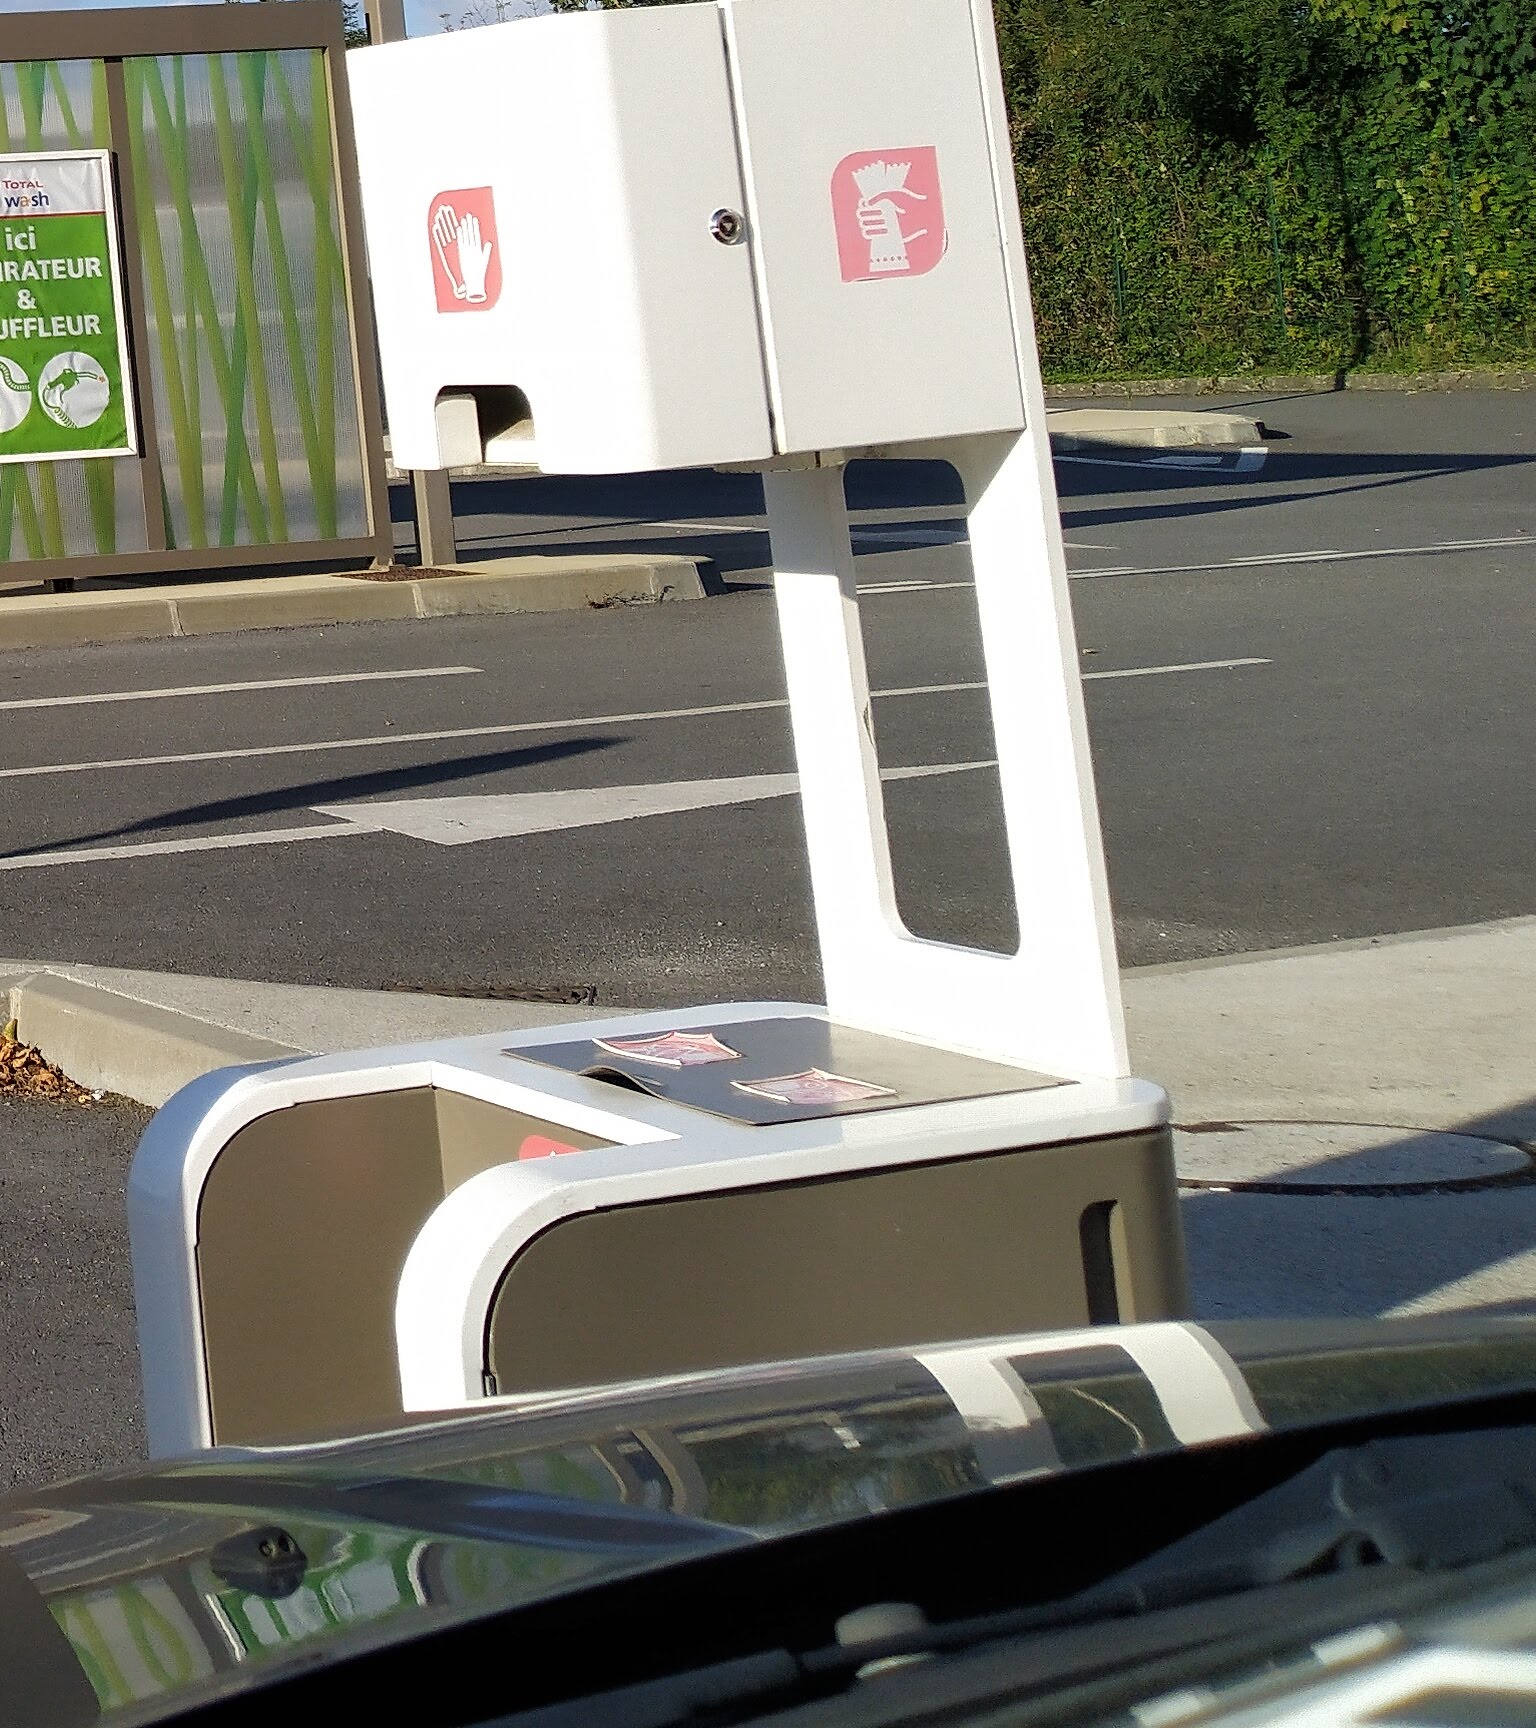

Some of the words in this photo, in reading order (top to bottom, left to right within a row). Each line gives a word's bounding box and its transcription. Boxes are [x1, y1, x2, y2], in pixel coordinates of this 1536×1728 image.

[1, 178, 44, 190] TOTAL
[5, 192, 50, 208] wash
[4, 225, 37, 251] ici
[16, 288, 37, 310] &
